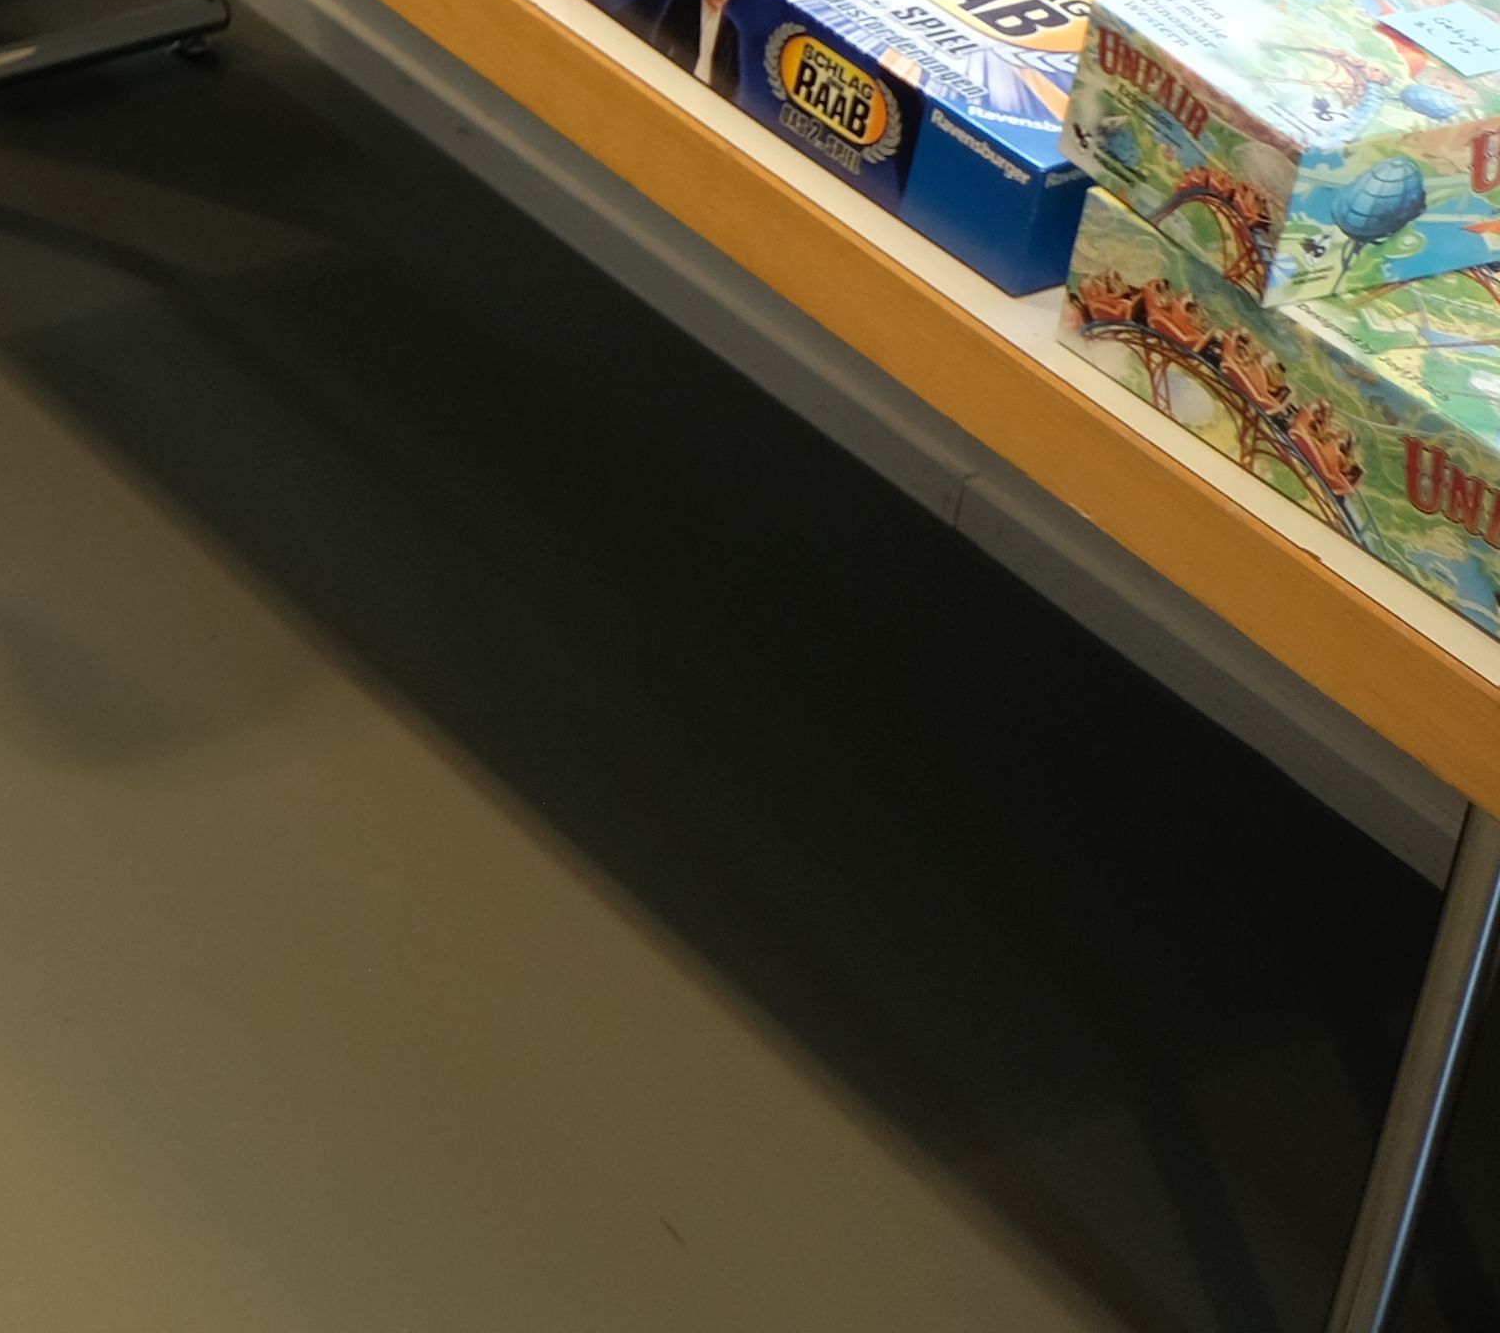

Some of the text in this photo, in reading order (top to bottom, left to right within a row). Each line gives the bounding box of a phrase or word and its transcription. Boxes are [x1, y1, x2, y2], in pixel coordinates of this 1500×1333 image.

[891, 3, 984, 59] SPIEL
[792, 62, 872, 141] RAAB
[802, 43, 875, 101] SCHLAG
[1099, 32, 1209, 133] UNFAIR
[931, 108, 1032, 188] Ravensburger
[966, 103, 1063, 134] Ravensb
